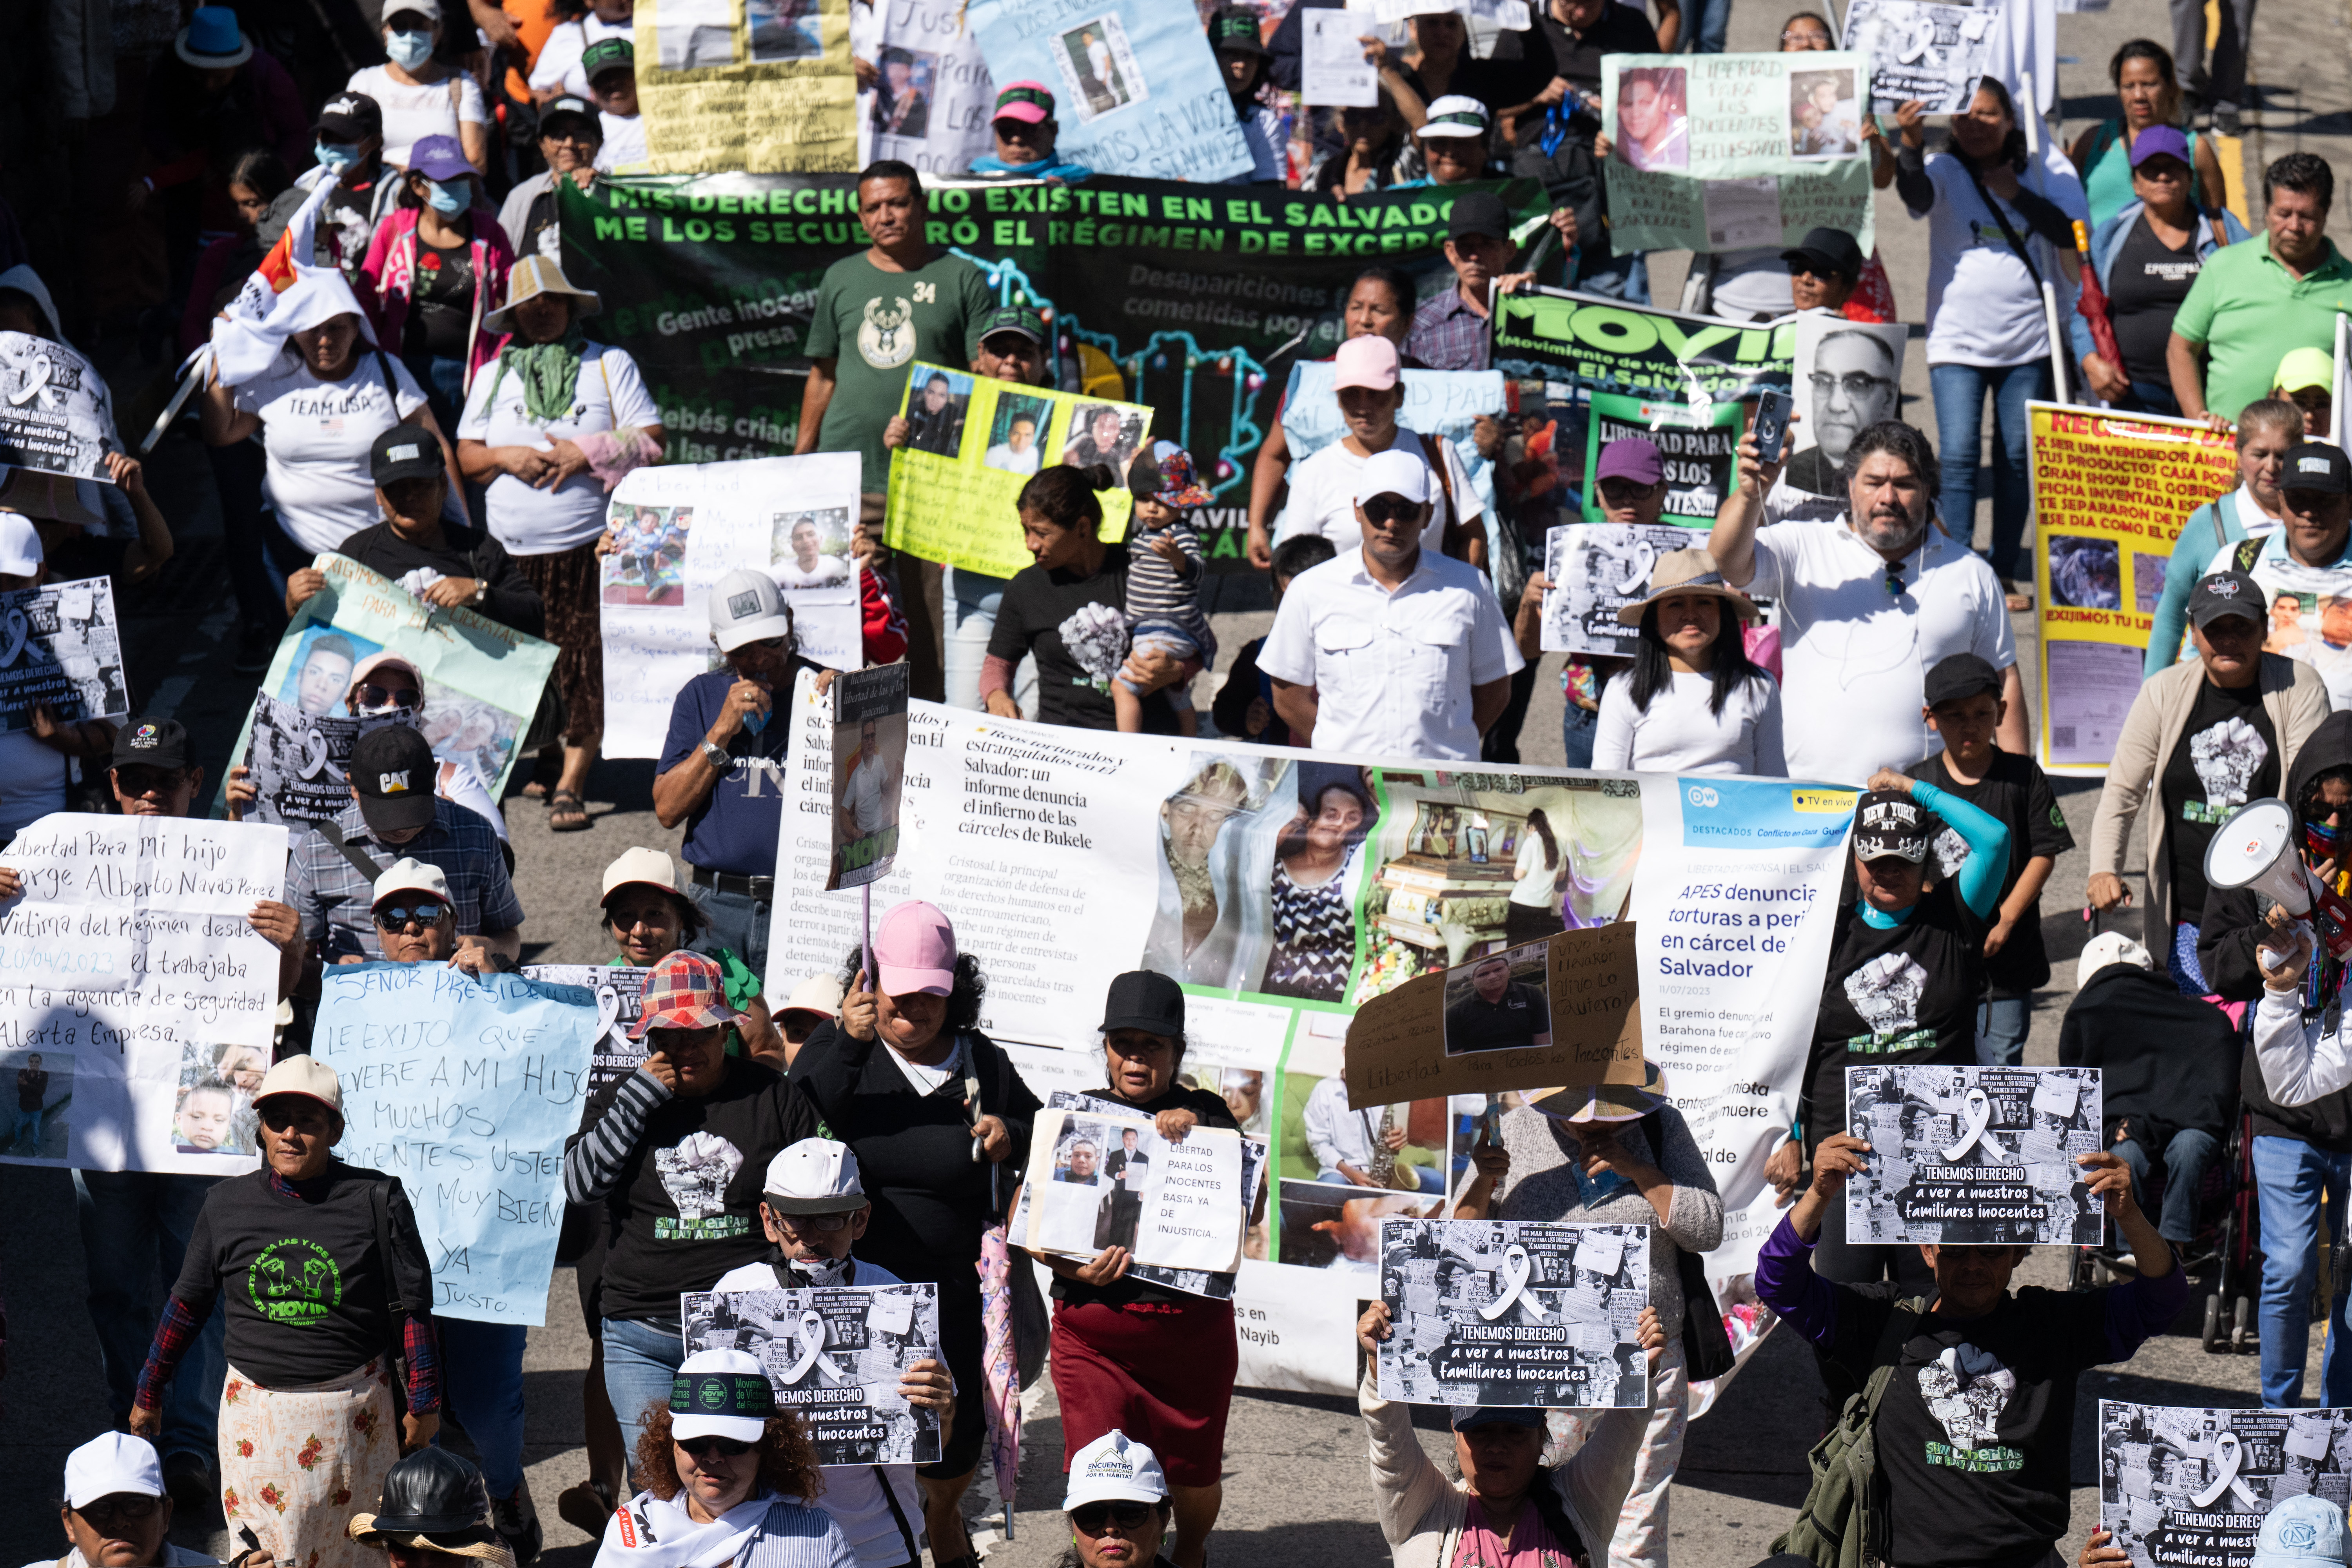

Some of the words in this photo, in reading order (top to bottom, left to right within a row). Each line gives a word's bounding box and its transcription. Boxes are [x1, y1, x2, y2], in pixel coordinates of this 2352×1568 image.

[610, 188, 675, 210] MIS
[986, 187, 1149, 216] EXISTEN
[1163, 196, 1213, 220] EN
[595, 216, 647, 241] ME
[665, 216, 736, 242] LOS
[1050, 218, 1224, 252] RÉGIMEN
[913, 281, 936, 304] 34
[1128, 263, 1327, 307] Desapariciones
[657, 305, 730, 336] Gente
[1123, 297, 1259, 328] cometidas
[727, 325, 796, 356] presa
[1504, 335, 1614, 365] Movimiento
[290, 398, 333, 415] TEAM
[339, 396, 373, 414] USA
[31, 412, 68, 426] DERECHO
[24, 425, 68, 441] nuestros
[27, 438, 76, 456] inocentes
[1686, 433, 1731, 456] PARA
[2050, 439, 2075, 452] SER
[2105, 445, 2189, 462] VENDEDOR
[1679, 461, 1711, 485] LOS
[2037, 450, 2062, 464] TUS
[2067, 454, 2155, 475] PRODUCTOS
[2161, 464, 2197, 479] CASA
[2038, 466, 2081, 480] GRAN
[2086, 470, 2131, 487] SHOW
[2134, 476, 2160, 491] DEL
[2039, 482, 2083, 497] FICHA
[2089, 486, 2174, 509] INVENTADA
[2062, 499, 2149, 521] SEPARARON
[2040, 513, 2064, 526] ESE
[2069, 515, 2096, 528] DIA
[2102, 518, 2143, 535] COMO
[363, 594, 396, 619] PARA
[449, 602, 524, 646] LIBERTAD
[2046, 610, 2109, 626] EXIJIMOS
[1587, 620, 1640, 638] familiares
[24, 664, 61, 679] DERECHO
[24, 678, 67, 694] nuestros
[967, 739, 1073, 766] estrangulados
[990, 730, 1027, 744] Reos
[1030, 740, 1113, 765] torturados
[965, 757, 1028, 778] Salvador:
[290, 780, 325, 795] TENEMOS
[379, 771, 410, 793] CAT
[965, 777, 1020, 798] informe
[1024, 786, 1086, 808] denuncia
[1807, 797, 1819, 805] TV
[280, 803, 330, 820] familiares
[979, 800, 1036, 820] infierno
[1863, 802, 1886, 826] NEW
[1891, 802, 1916, 824] YORK
[958, 820, 1019, 839] cárceles
[1044, 829, 1092, 848] Bukele
[1693, 825, 1752, 837] DESTACADOS
[1757, 829, 1791, 837] Conflicto
[1881, 820, 1896, 830] NY
[2, 835, 77, 858] Libertad
[86, 830, 127, 857] Para
[183, 835, 227, 870] hijo
[949, 855, 996, 871] Cristosal,
[1011, 863, 1058, 880] principal
[18, 868, 72, 900] orge
[86, 864, 172, 899] Alberto
[180, 872, 233, 895] Navas
[238, 877, 275, 898] Pérez
[1678, 884, 1722, 900] APES
[1669, 908, 1742, 926] torturas
[119, 914, 190, 944] Régimen
[202, 916, 252, 937] desde
[1690, 933, 1755, 951] cárcel
[0, 946, 113, 975] 20/04/2023
[159, 951, 247, 982] trabajaba
[1660, 957, 1753, 976] Salvador
[334, 968, 423, 1004] SEÑOR
[1659, 985, 1711, 996] 11/07/2023
[66, 990, 140, 1017] agencia
[1674, 1009, 1715, 1020] gremio
[0, 1020, 76, 1048] Alerta
[329, 1025, 350, 1055] LE
[363, 1020, 452, 1053] EXIJO
[1660, 1024, 1716, 1037] Barahona
[1660, 1042, 1708, 1055] régimen
[1710, 1045, 1721, 1054] de
[1460, 1056, 1492, 1071] Para
[1500, 1050, 1545, 1069] Todos
[1661, 1060, 1693, 1072] preso
[1696, 1062, 1711, 1073] por
[431, 1057, 448, 1088] A
[463, 1056, 498, 1090] MI
[524, 1055, 591, 1104] HIJO
[374, 1097, 495, 1135] MUCHOS
[1171, 1144, 1213, 1157] LIBERTAD
[492, 1139, 564, 1183] USTED
[1168, 1161, 1192, 1172] PARA
[1195, 1163, 1212, 1172] LOS
[1165, 1176, 1221, 1189] INOCENTES
[1926, 1167, 1974, 1180] TENEMOS
[1976, 1167, 2025, 1180] DERECHO
[1163, 1193, 1192, 1205] BASTA
[1198, 1196, 1209, 1205] YA
[1929, 1187, 1951, 1198] ver
[1970, 1185, 2028, 1199] nuestros
[439, 1178, 491, 1217] MUY
[498, 1189, 562, 1227] BIEN
[1906, 1202, 1973, 1218] familiares
[1978, 1204, 2044, 1218] inocentes
[1161, 1209, 1174, 1218] DE
[1158, 1225, 1217, 1239] INJUSTICIA..
[255, 1243, 277, 1265] PARA
[310, 1243, 329, 1259] LOS
[1250, 1308, 1266, 1320] en
[1240, 1327, 1279, 1345] Nayib
[1462, 1326, 1512, 1340] TENEMOS
[1514, 1327, 1565, 1341] DERECHO
[1465, 1346, 1488, 1358] ver
[1509, 1347, 1569, 1360] nuestros
[1439, 1363, 1512, 1379] familiares
[1517, 1365, 1585, 1381] inocentes
[736, 1390, 744, 1399] de
[814, 1388, 862, 1402] DERECHO
[809, 1408, 867, 1423] nuestros
[818, 1426, 885, 1441] inocentes
[1927, 1454, 1942, 1465] NO
[1945, 1457, 1965, 1469] HAY
[1107, 1471, 1132, 1479] HÁBITAT
[2174, 1511, 2229, 1528] TENEMOS
[2178, 1532, 2200, 1544] ver
[2155, 1545, 2223, 1566] familiares
